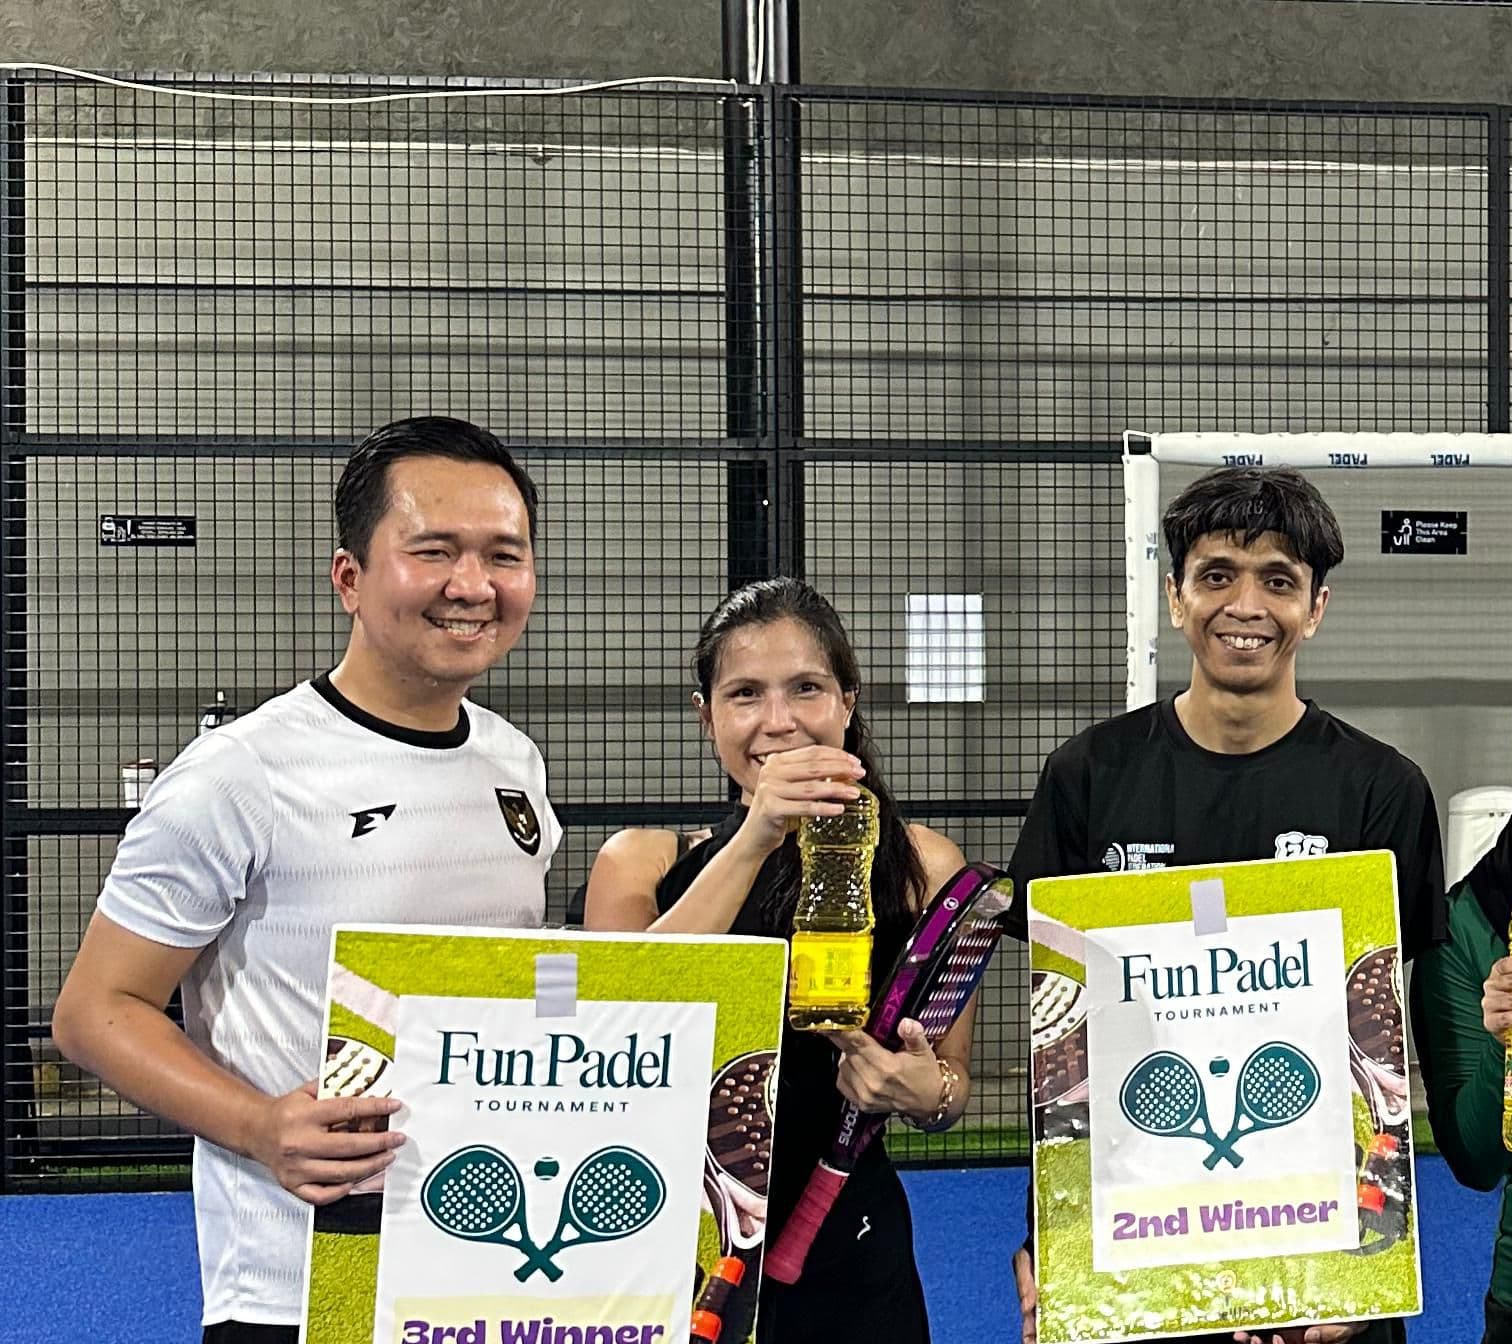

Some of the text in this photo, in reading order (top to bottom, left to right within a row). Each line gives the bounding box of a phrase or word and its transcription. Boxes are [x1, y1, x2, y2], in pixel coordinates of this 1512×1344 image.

[1222, 455, 1263, 466] PADEL
[1329, 454, 1367, 466] PADEL
[1431, 454, 1470, 466] PADEL
[1440, 522, 1458, 530] Keep
[1118, 939, 1313, 1002] Fun Padel
[1154, 1002, 1280, 1022] TOURNAMENT
[433, 1030, 673, 1088] Fun Padel
[474, 1098, 631, 1113] TOURNAMENT
[1112, 1199, 1338, 1240] 2nd Winner
